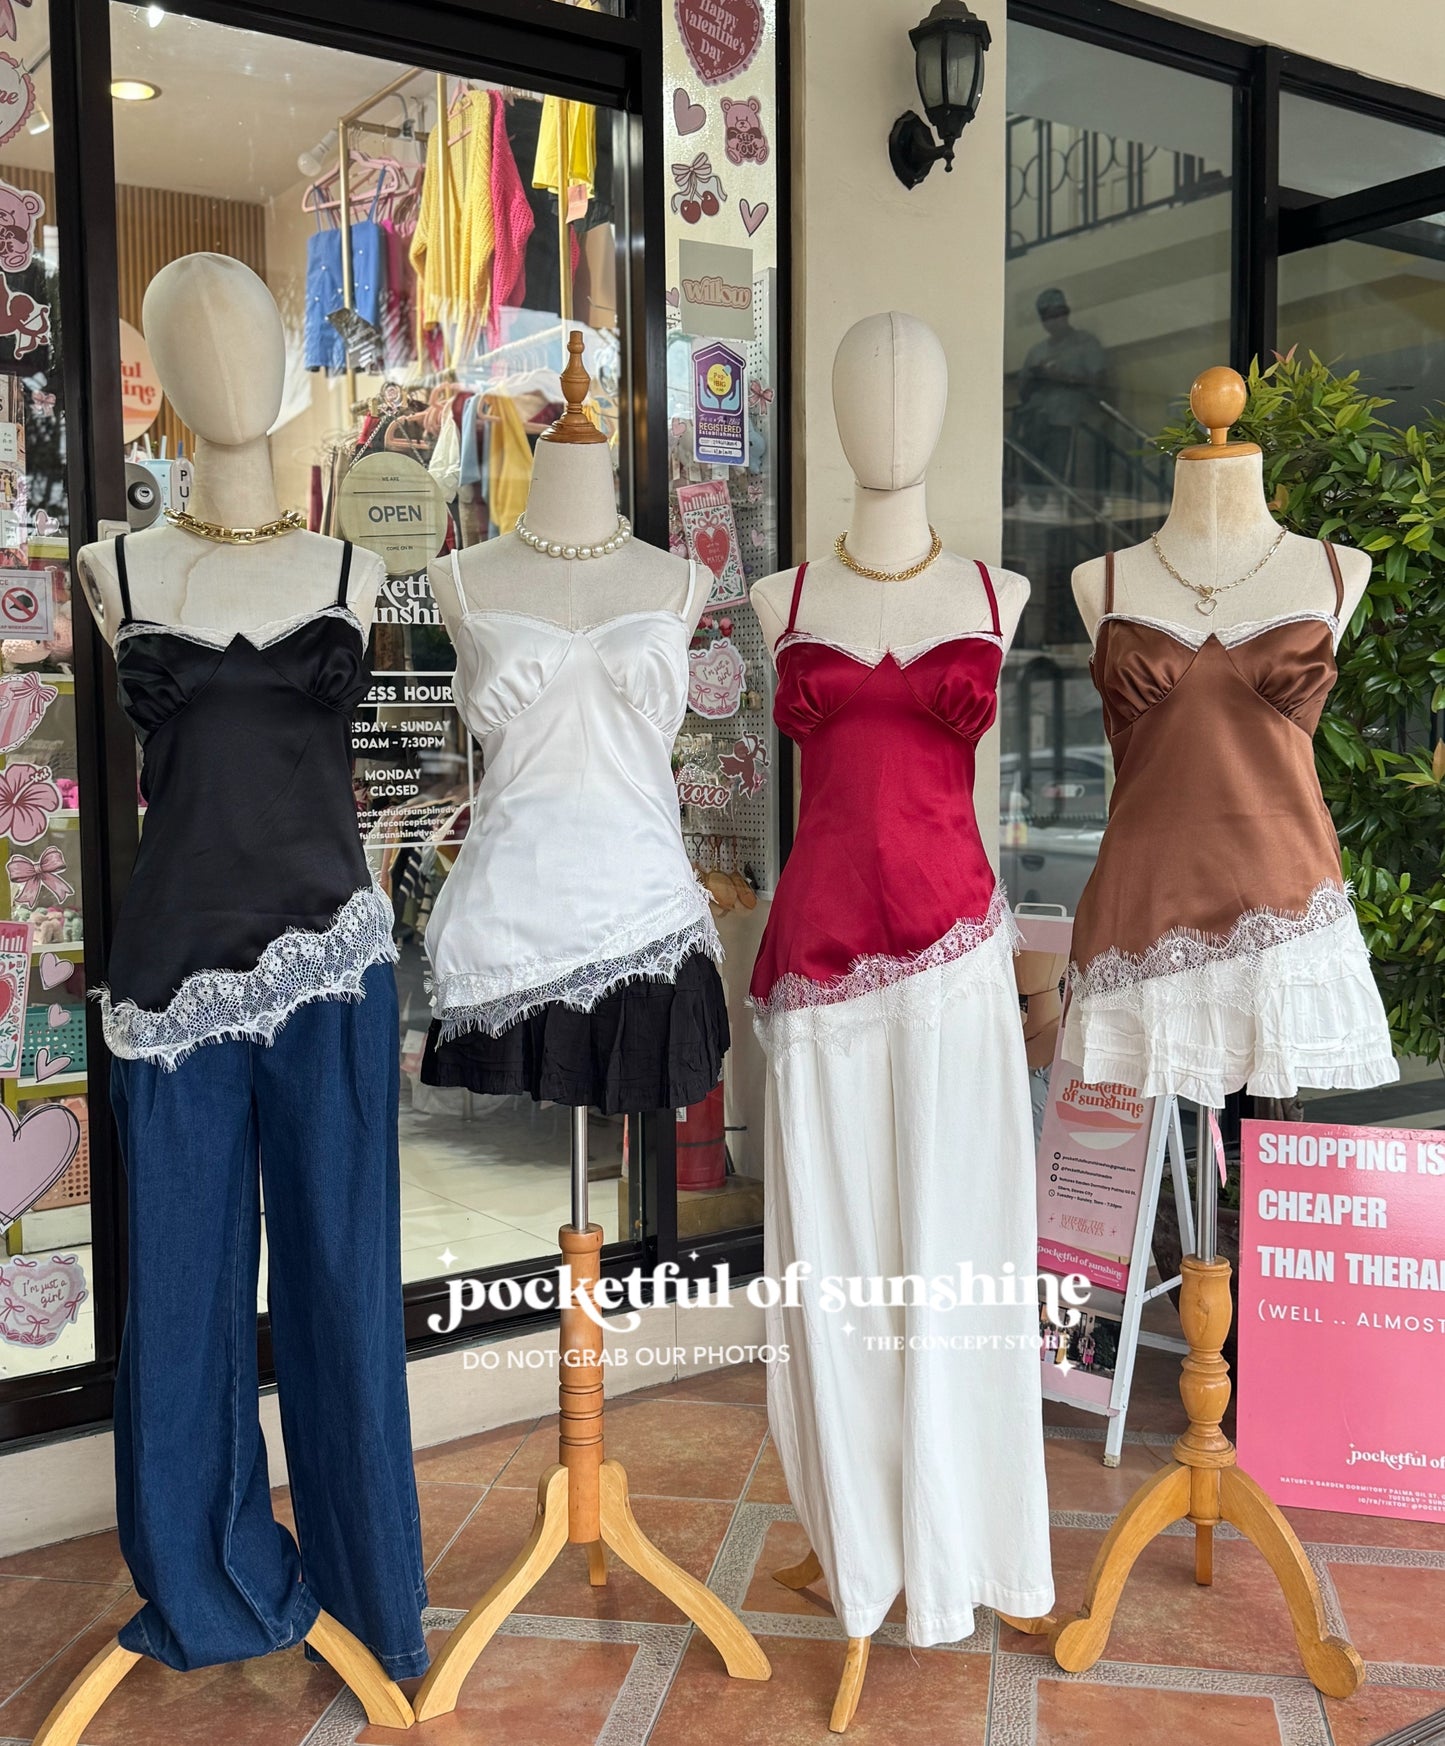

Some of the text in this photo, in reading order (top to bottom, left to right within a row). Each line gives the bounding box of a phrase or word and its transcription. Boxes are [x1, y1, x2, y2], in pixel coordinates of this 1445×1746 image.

[699, 0, 739, 34] Happy
[685, 8, 746, 56] Valentine's
[700, 38, 725, 66] Day
[736, 132, 755, 142] SELF
[735, 142, 759, 154] LOVE
[699, 422, 742, 434] REGISTERED
[368, 505, 422, 523] OPEN
[364, 686, 397, 701] ESS
[400, 721, 451, 732] SUNDAY
[400, 737, 446, 748] 7:30PM
[364, 768, 421, 781] MONDAY
[370, 784, 419, 797] CLOSED
[1062, 1088, 1144, 1119] of sunshine
[1258, 1133, 1445, 1176] SHOPPING IS
[1258, 1189, 1388, 1229] CHEAPER
[1037, 1245, 1079, 1263] pocketful
[1079, 1258, 1089, 1267] of
[1088, 1262, 1122, 1280] sunshine
[1257, 1245, 1445, 1292] THAN THERA
[23, 1279, 39, 1296] I'm
[40, 1279, 58, 1294] just
[41, 1289, 64, 1308] girl
[1258, 1298, 1323, 1323] (WELL
[1346, 1450, 1427, 1471] pocketful
[1280, 1477, 1314, 1486] NATURE'S
[1315, 1480, 1344, 1489] GARDEN
[1345, 1484, 1388, 1494] DORMITORY
[1388, 1488, 1414, 1497] PALMA
[1388, 1494, 1420, 1504] TUESDAY
